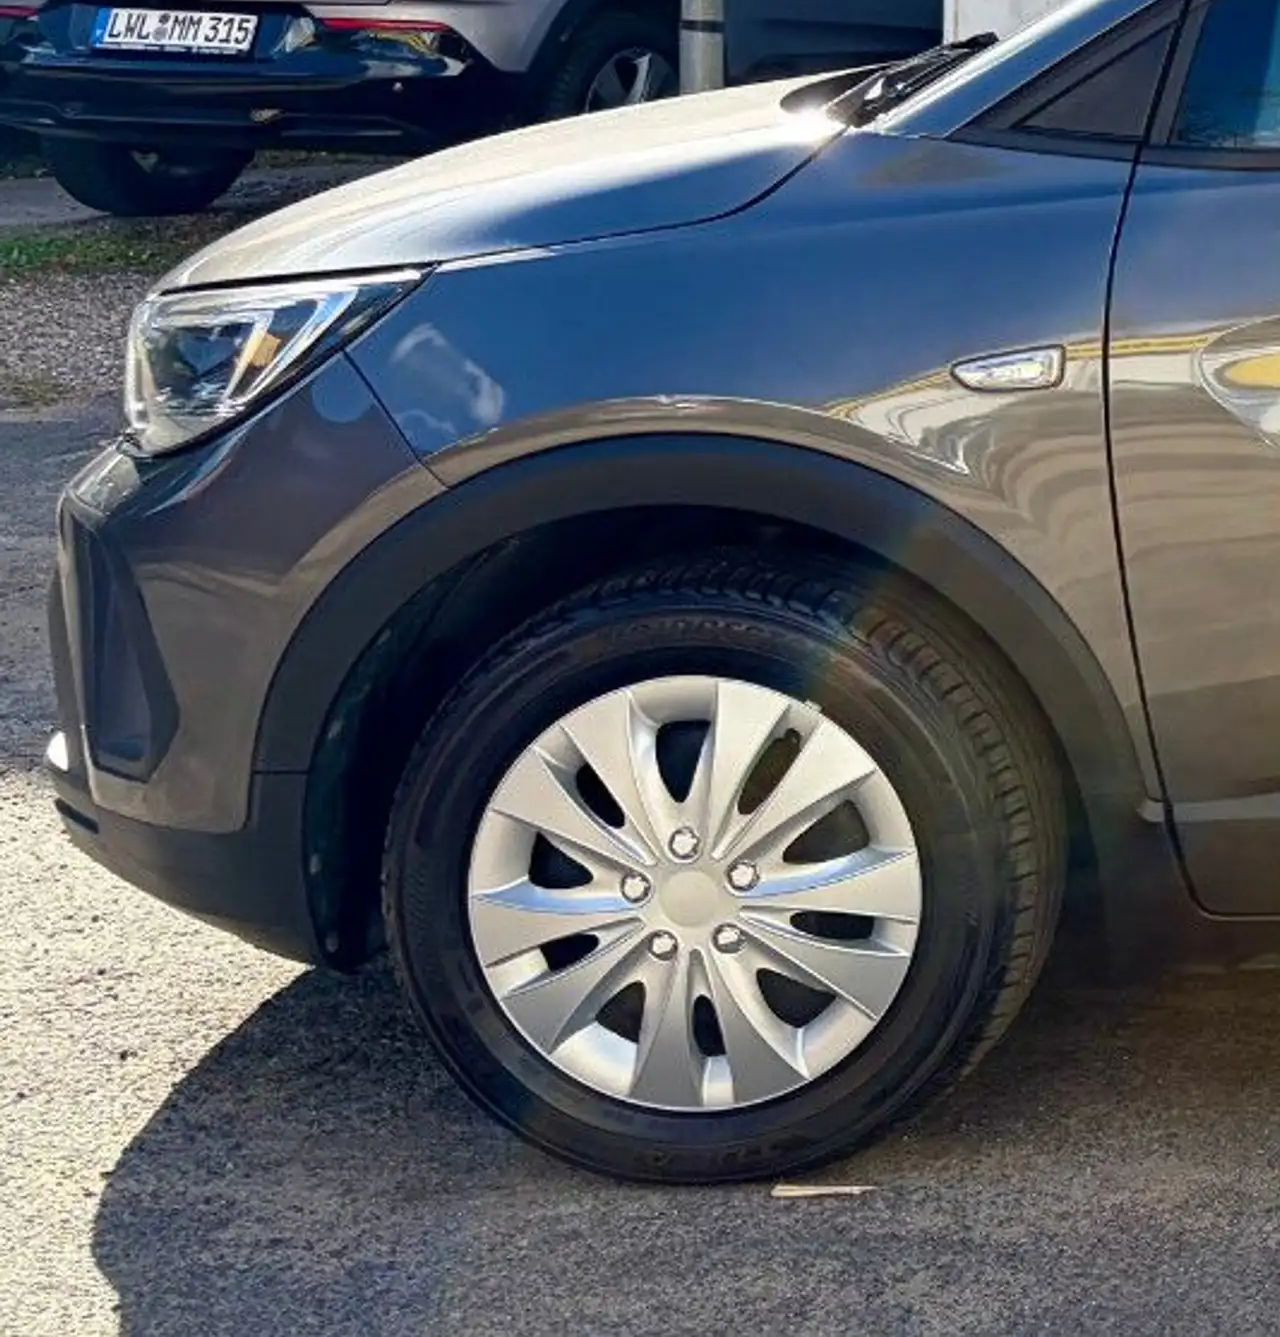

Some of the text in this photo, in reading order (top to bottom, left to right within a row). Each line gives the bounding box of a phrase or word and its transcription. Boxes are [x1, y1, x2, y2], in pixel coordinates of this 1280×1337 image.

[108, 12, 251, 44] LWL MM 315
